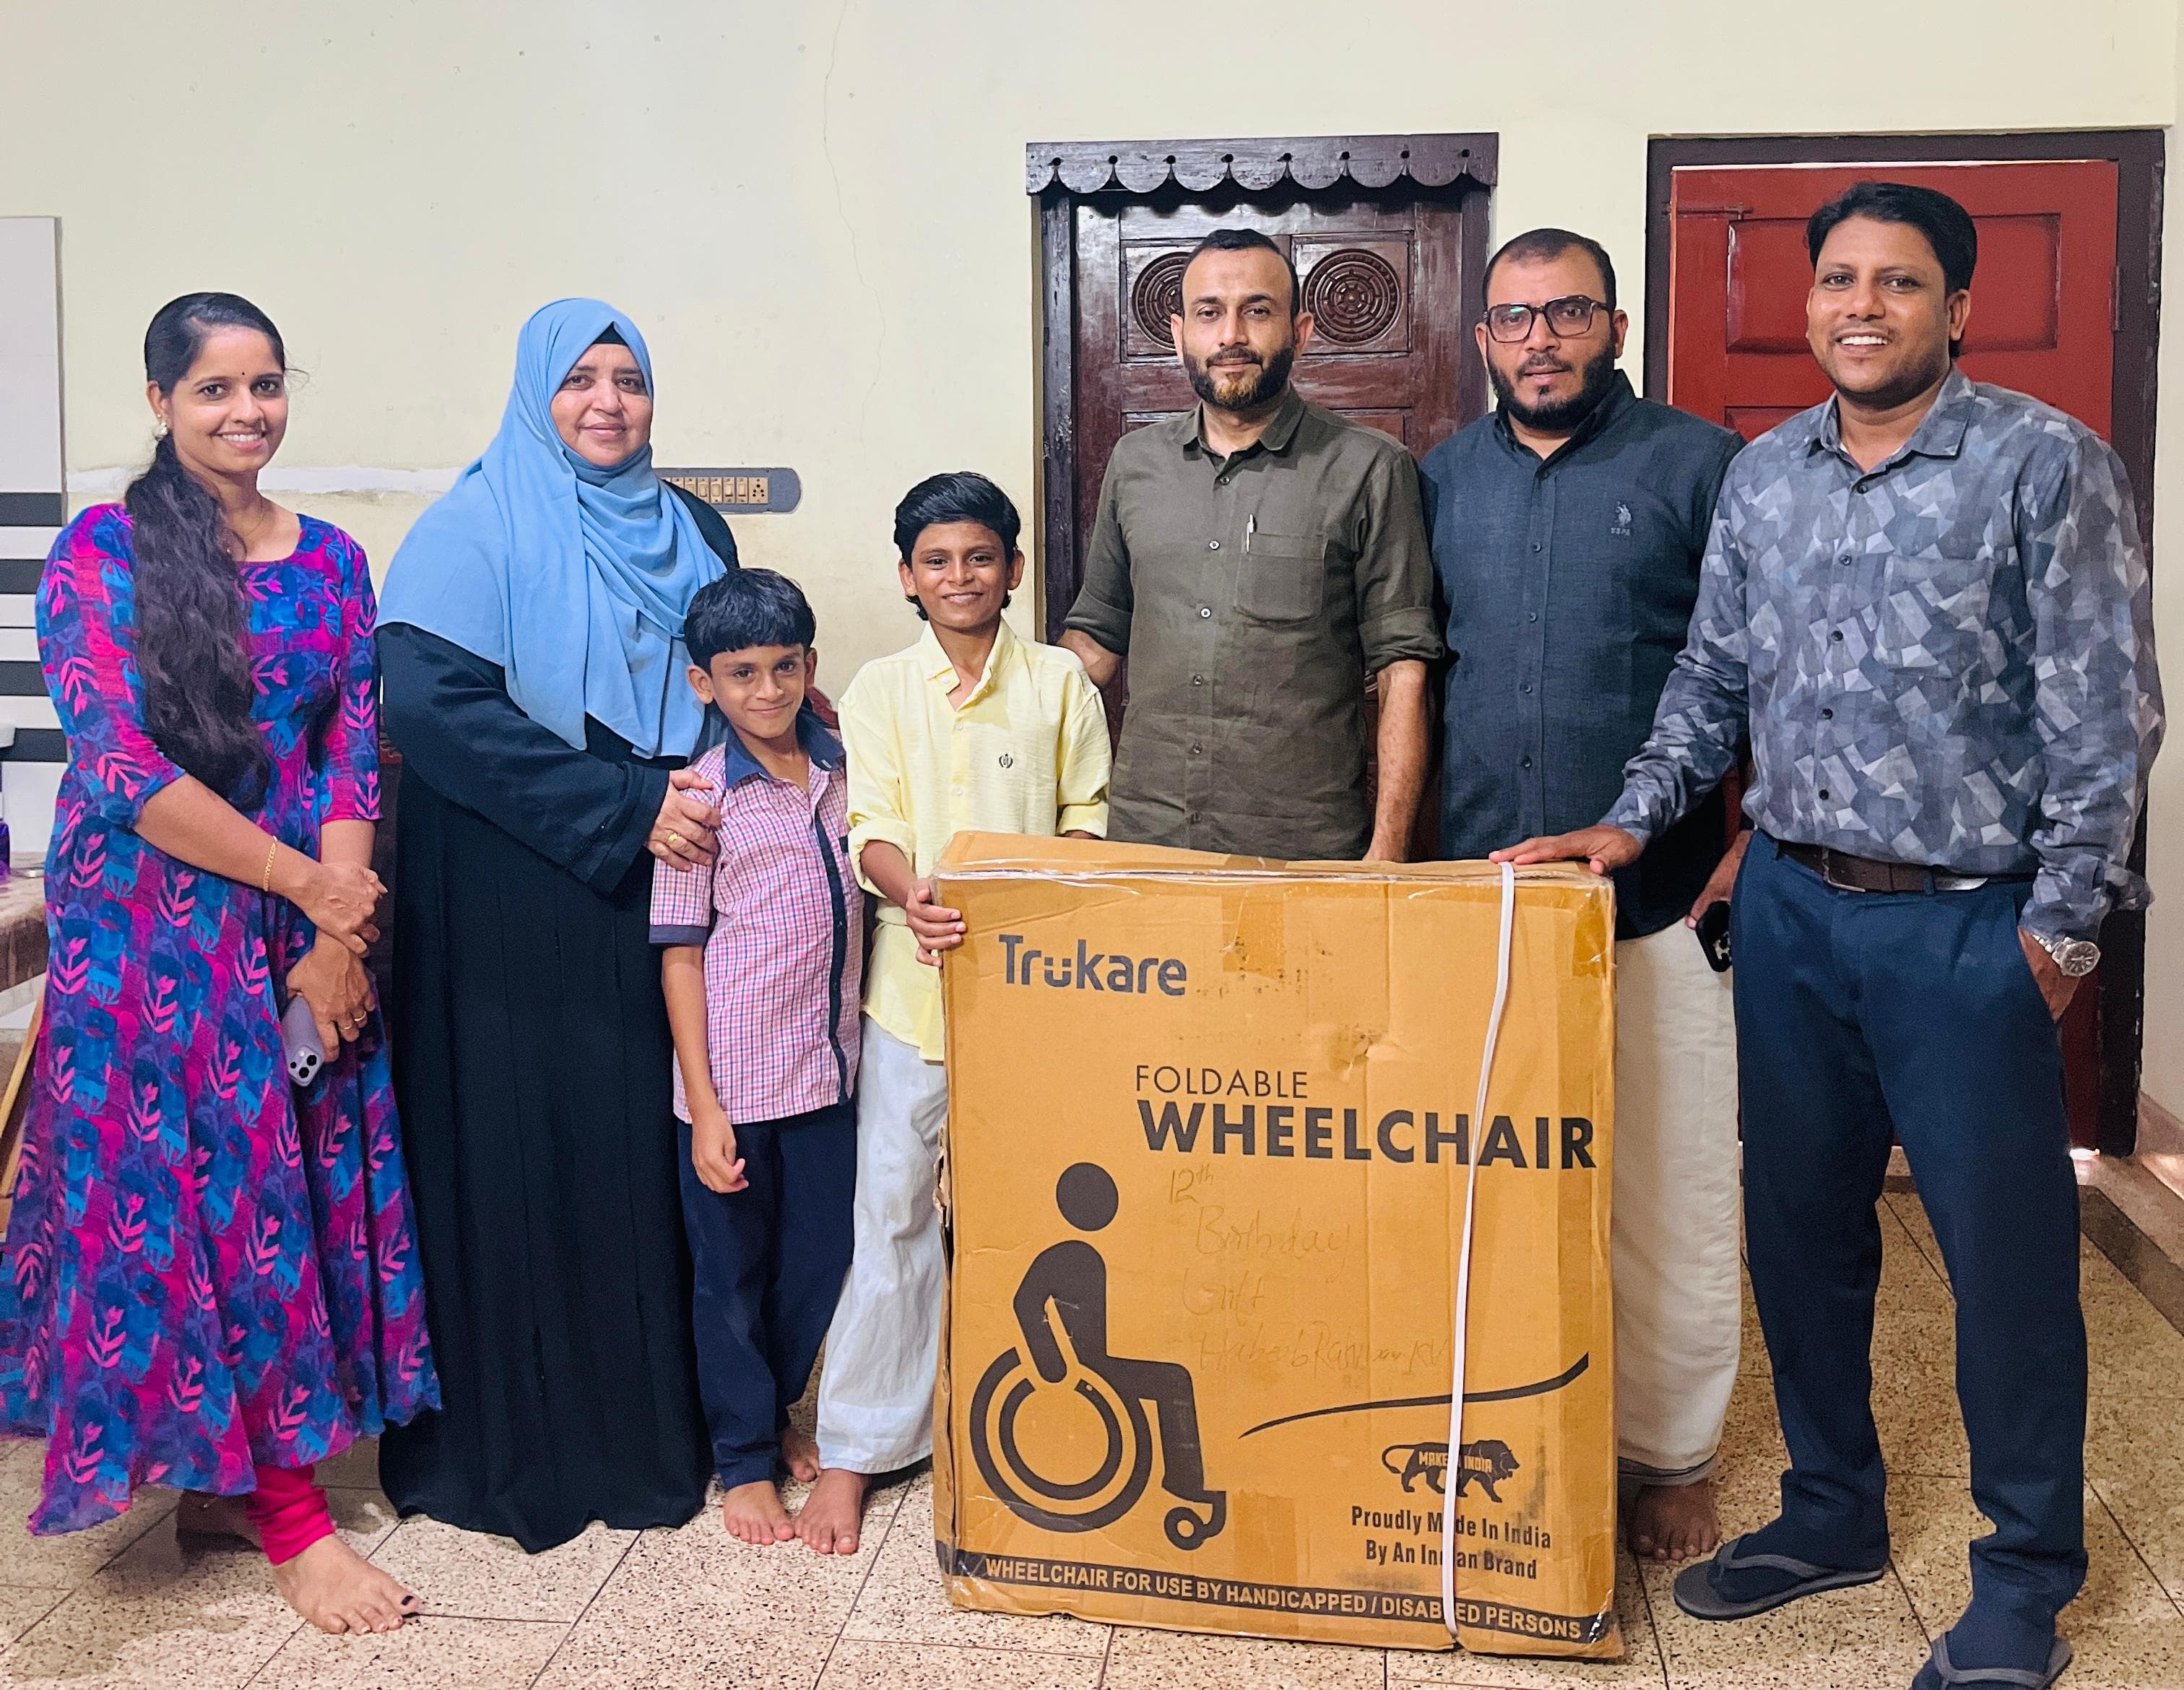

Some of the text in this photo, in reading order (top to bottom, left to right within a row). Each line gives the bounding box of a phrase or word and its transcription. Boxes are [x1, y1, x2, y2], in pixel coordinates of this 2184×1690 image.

[998, 934, 1187, 997] Trükare
[1135, 1065, 1308, 1099] FOLDABLE
[1138, 1099, 1597, 1169] WHEELCHAIR
[1168, 1163, 1214, 1205] 12th
[1464, 1455, 1492, 1473] INDIA
[1351, 1506, 1551, 1549] Proudly Mde In India
[1366, 1539, 1537, 1579] By An Inan Brand
[985, 1558, 1109, 1588] WHEELCHAIR
[1112, 1570, 1151, 1592] FOR
[1156, 1577, 1192, 1598] USE
[1197, 1581, 1222, 1602] BY
[1226, 1585, 1367, 1614] HANDICAPPED
[1382, 1597, 1481, 1624] DISABED
[1486, 1605, 1582, 1639] PERSONS
